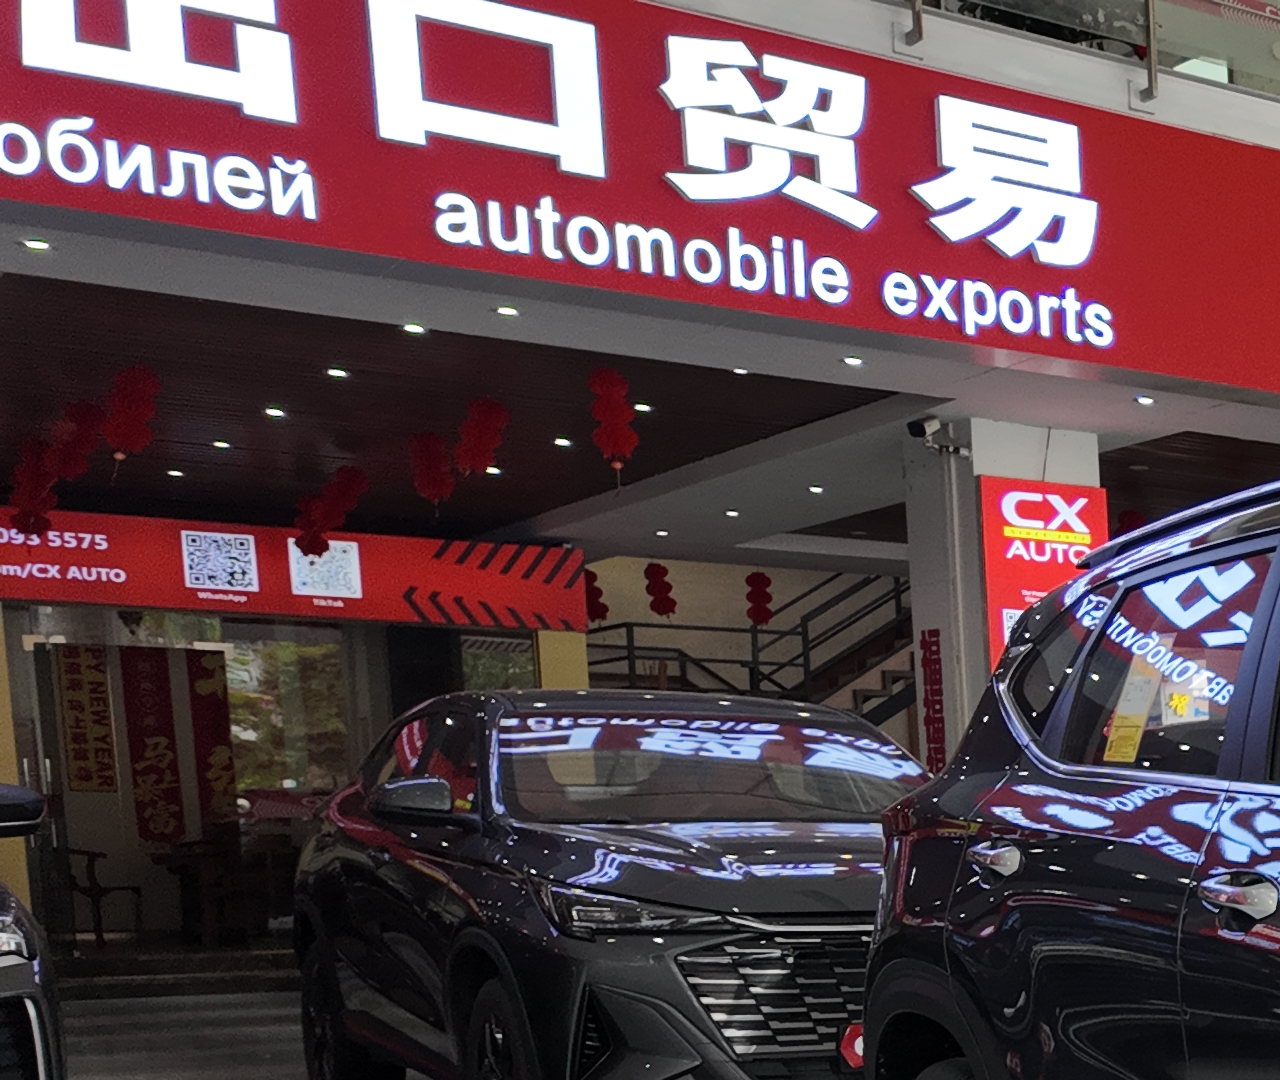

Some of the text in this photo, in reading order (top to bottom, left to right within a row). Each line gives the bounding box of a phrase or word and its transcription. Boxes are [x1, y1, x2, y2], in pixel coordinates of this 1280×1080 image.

[0, 116, 318, 221] обилей
[434, 191, 1116, 349] automobile exports
[1001, 490, 1091, 533] CX
[47, 530, 109, 550] 5575
[1005, 540, 1092, 566] AUTO
[0, 563, 127, 583] m/CX AUTO
[87, 681, 110, 727] NEW
[93, 734, 116, 788] YEAR
